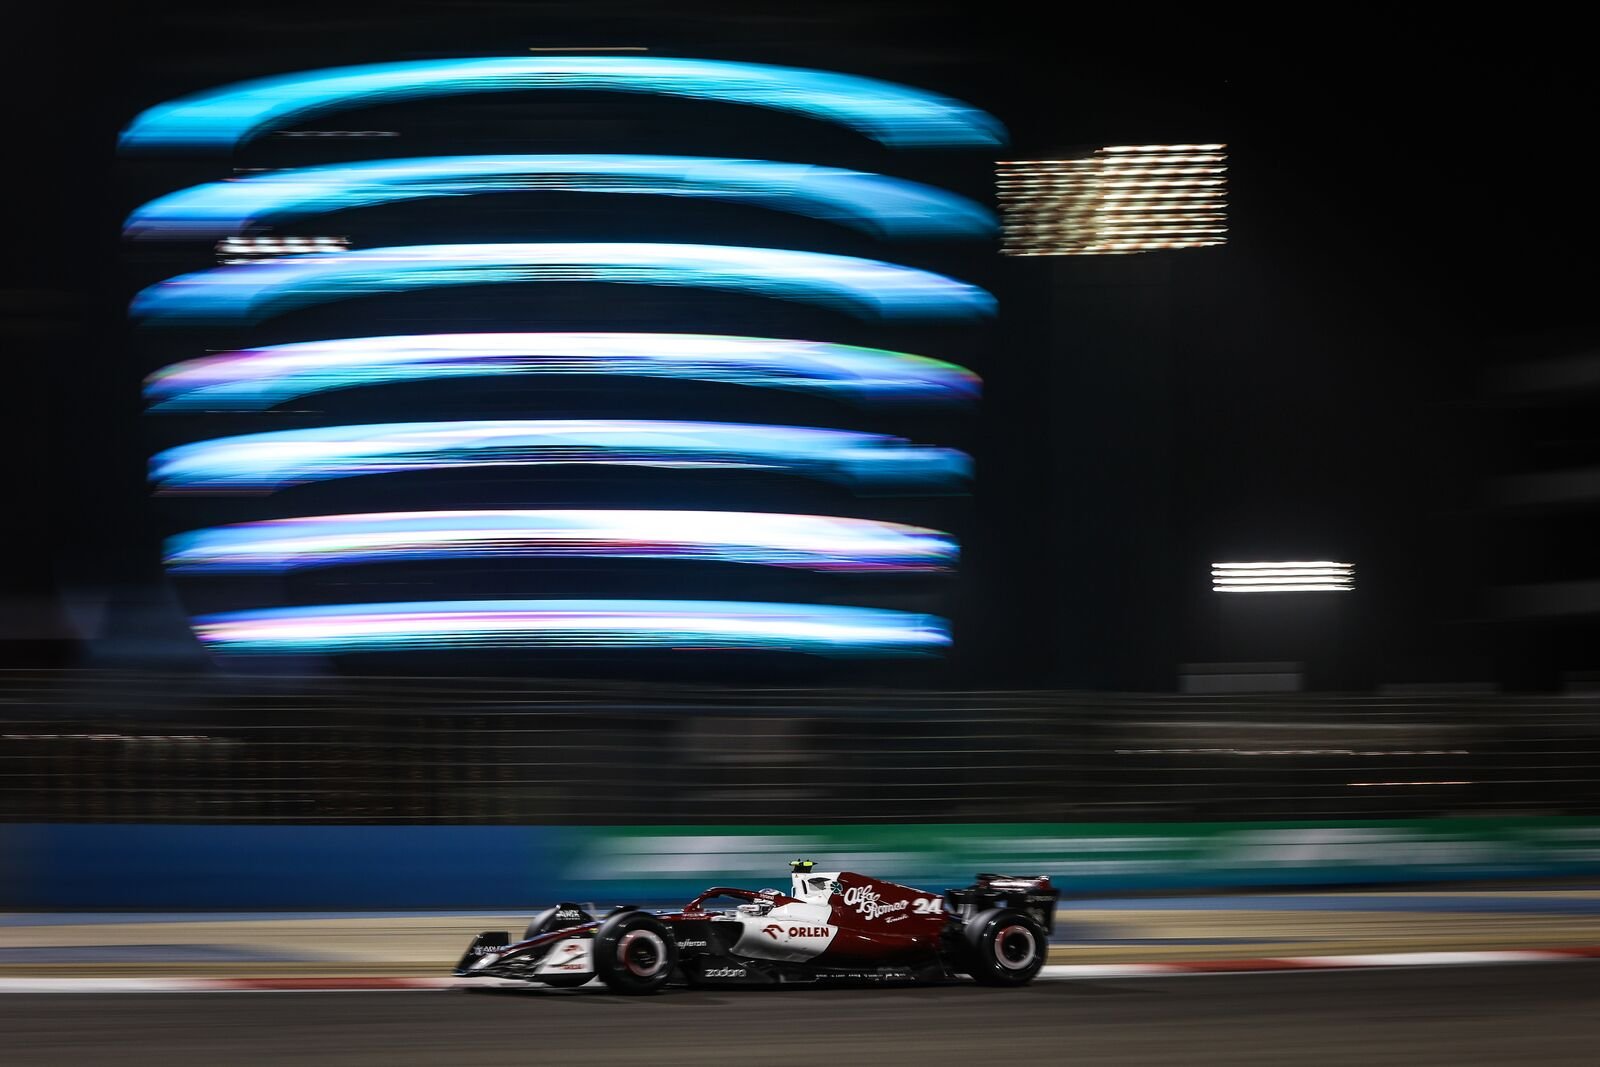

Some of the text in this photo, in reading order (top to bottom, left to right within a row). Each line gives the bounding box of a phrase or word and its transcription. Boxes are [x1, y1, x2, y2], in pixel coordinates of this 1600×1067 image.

[844, 885, 881, 905] Alfa
[856, 900, 909, 921] Romeo
[912, 898, 943, 914] 24
[788, 927, 829, 937] ORLEN
